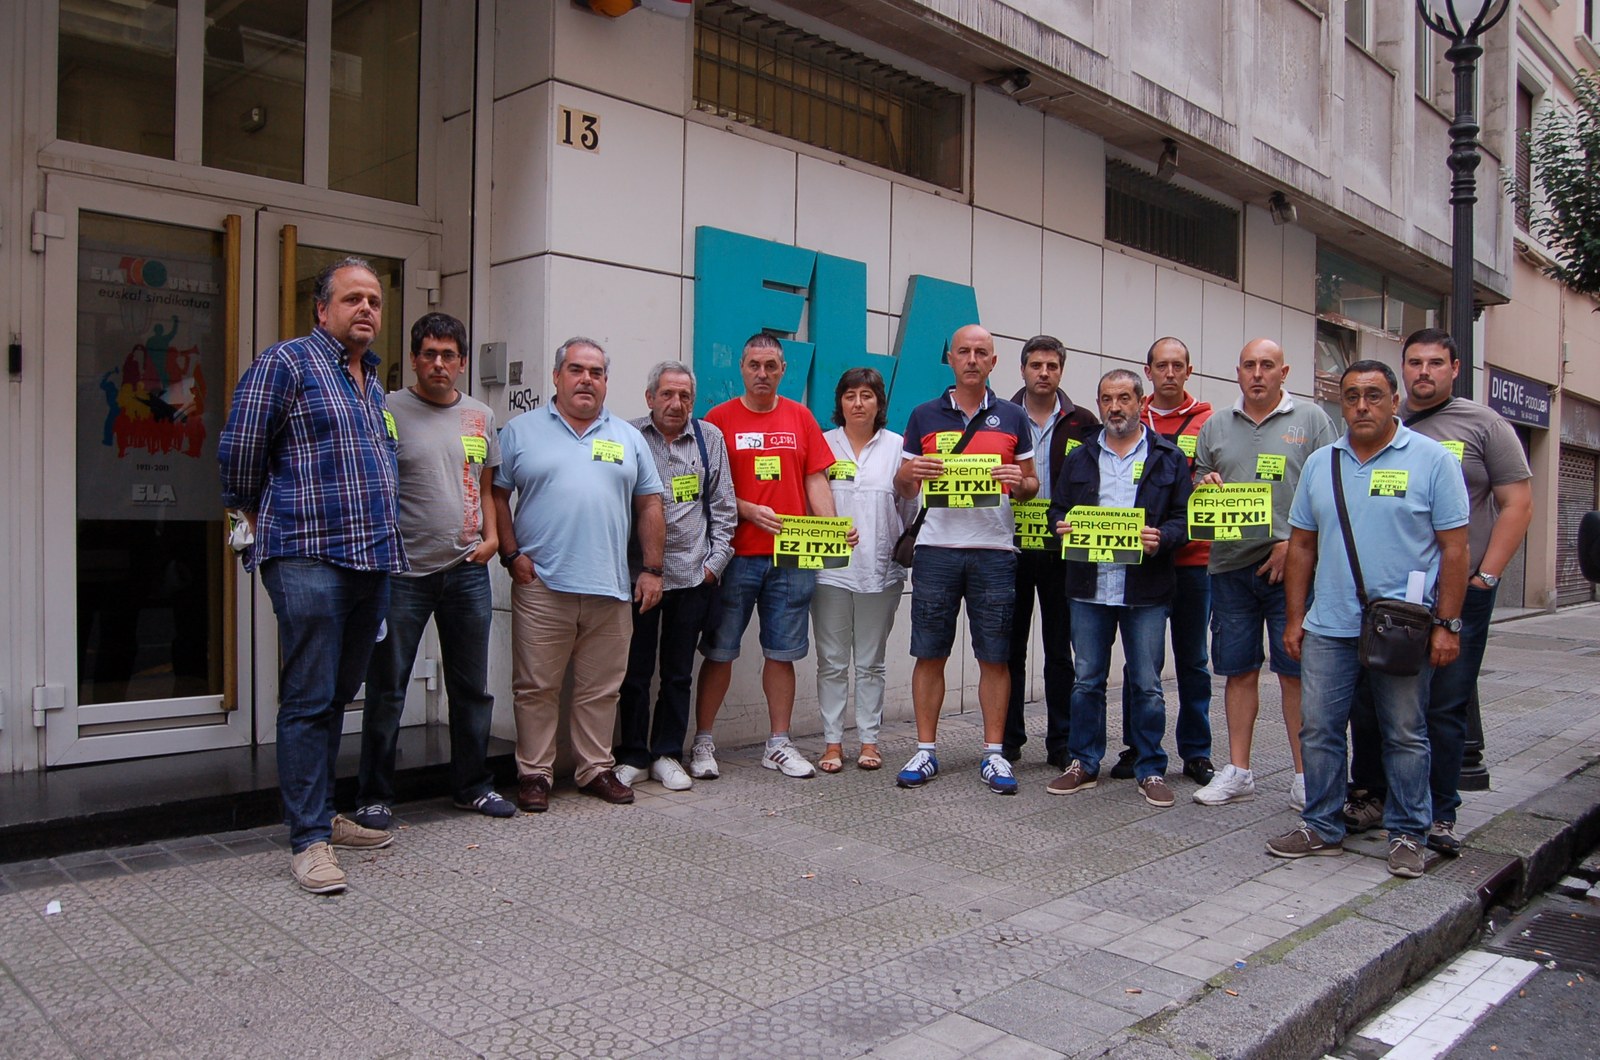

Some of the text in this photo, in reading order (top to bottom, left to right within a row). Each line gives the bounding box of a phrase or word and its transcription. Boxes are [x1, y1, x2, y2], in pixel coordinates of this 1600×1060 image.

[563, 109, 599, 150] 13
[98, 288, 210, 309] euskal sindikatua
[693, 225, 990, 434] ELA
[1492, 377, 1524, 405] DIETXE
[943, 467, 992, 476] RKEMA
[929, 480, 996, 492] EZ ITXI!
[132, 483, 177, 502] ELA
[948, 495, 974, 507] ELA
[1194, 511, 1266, 523] EZ ITXI!
[1015, 523, 1023, 534] Z
[1215, 527, 1242, 539] ELA
[1021, 537, 1044, 548] ELA
[1069, 534, 1139, 547] EZ ITXI!
[780, 541, 847, 554] EZ ITXI!
[1088, 549, 1114, 561] ELA
[798, 556, 824, 567] ELA
